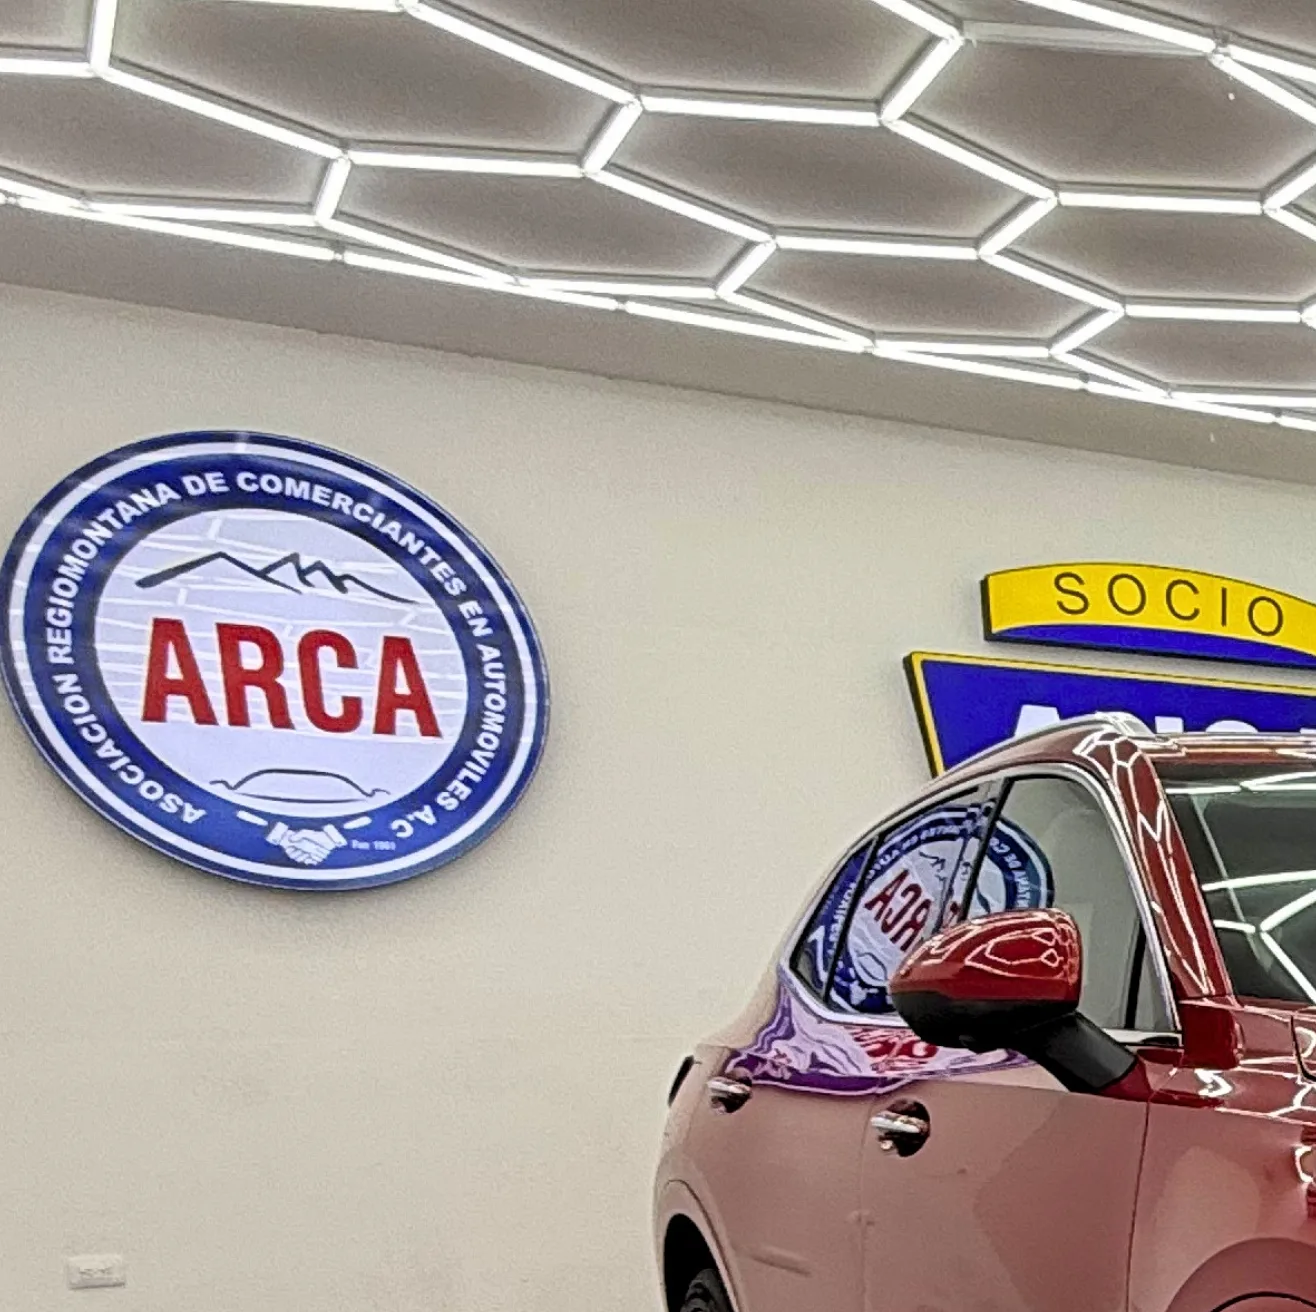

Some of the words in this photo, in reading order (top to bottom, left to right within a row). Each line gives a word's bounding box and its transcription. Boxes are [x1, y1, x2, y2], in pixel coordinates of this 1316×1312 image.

[181, 472, 230, 496] DE
[236, 471, 467, 596] COMERCIANTES
[46, 482, 182, 665] REGIOMONTANA
[458, 600, 494, 638] EN
[1053, 571, 1284, 637] SOCIO
[140, 616, 443, 739] ARCA
[436, 643, 507, 812] AUTOMOVILES
[52, 673, 207, 825] ASOCIACION
